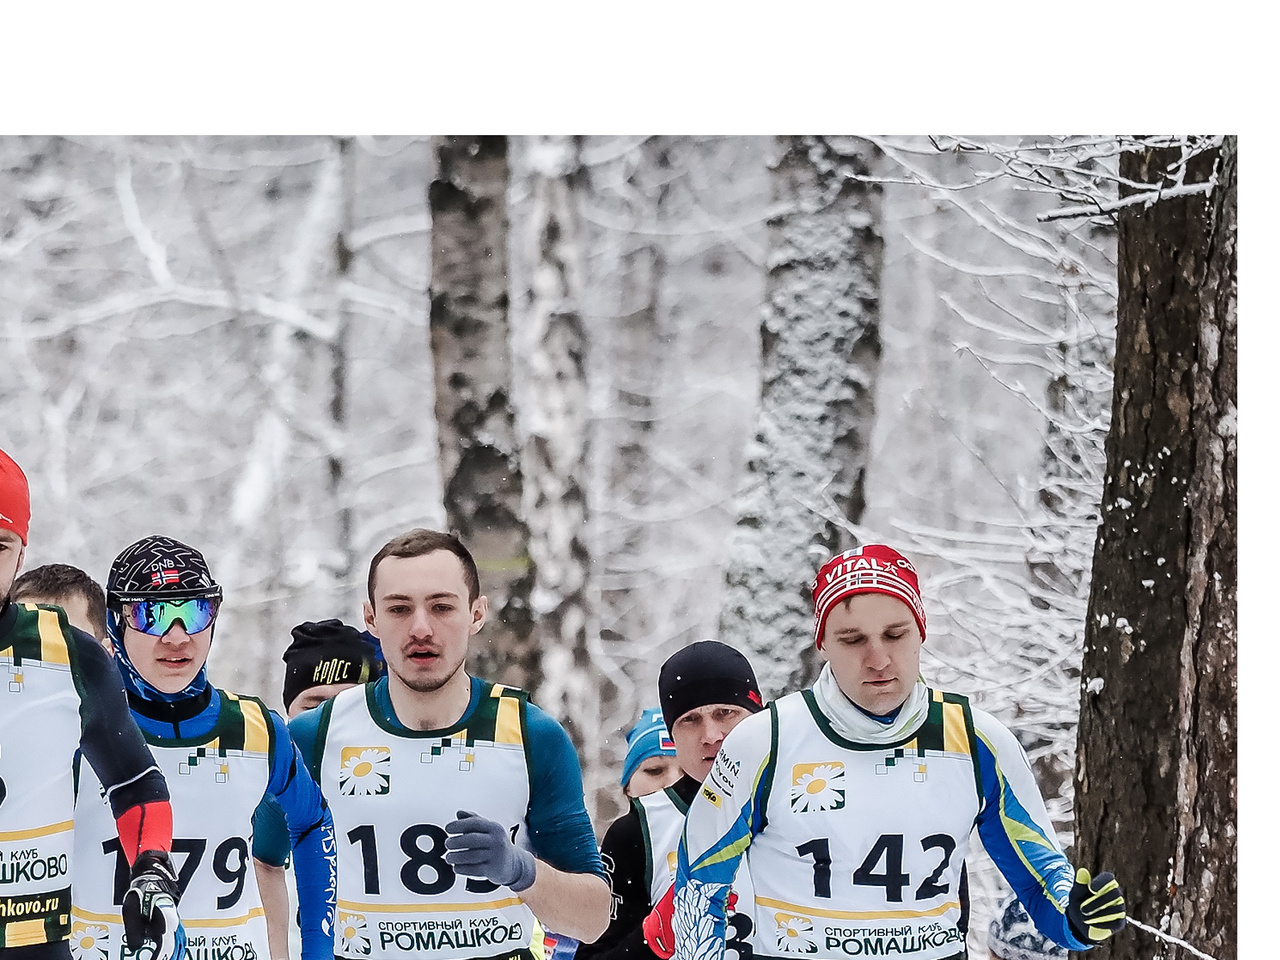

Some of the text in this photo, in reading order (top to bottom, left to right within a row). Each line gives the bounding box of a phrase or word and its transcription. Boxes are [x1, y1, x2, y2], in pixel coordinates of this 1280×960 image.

[825, 558, 883, 583] VITAL
[11, 848, 39, 861] КЛУБ
[347, 824, 503, 895] 18
[102, 836, 249, 910] 179
[795, 833, 957, 903] 142
[378, 917, 499, 931] СПОРТИВНЫЙ КЛУБ
[825, 925, 912, 938] СПОРТИВНЫЙ
[212, 935, 237, 947] КЛУБ
